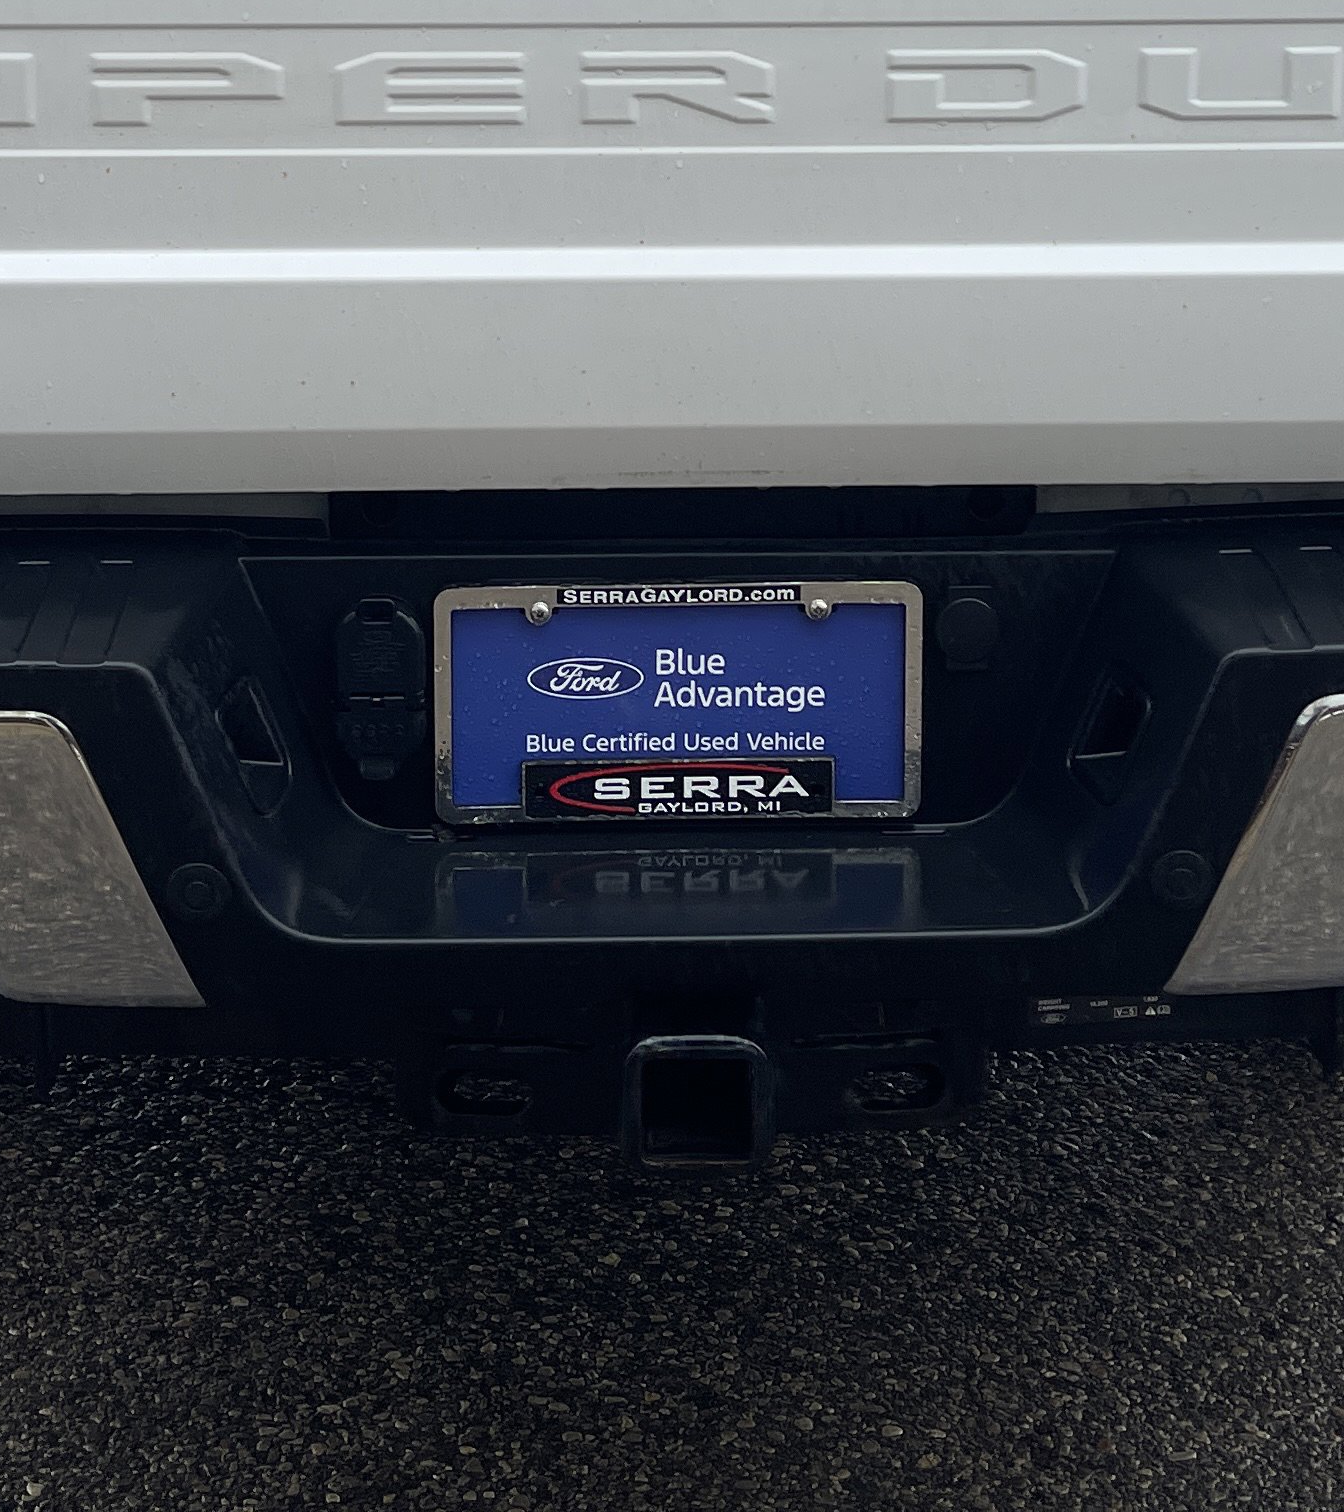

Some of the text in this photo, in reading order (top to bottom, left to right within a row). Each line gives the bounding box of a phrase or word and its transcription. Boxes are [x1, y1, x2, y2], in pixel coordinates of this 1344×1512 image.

[562, 585, 796, 605] SERRAGAYLORD.com
[655, 647, 726, 676] Blue
[548, 662, 623, 694] Ford
[653, 680, 826, 713] Advantage
[525, 731, 825, 753] Blue Certified Used Vehicle
[593, 775, 810, 800] SERRA
[637, 800, 782, 814] GAYLORD, MI
